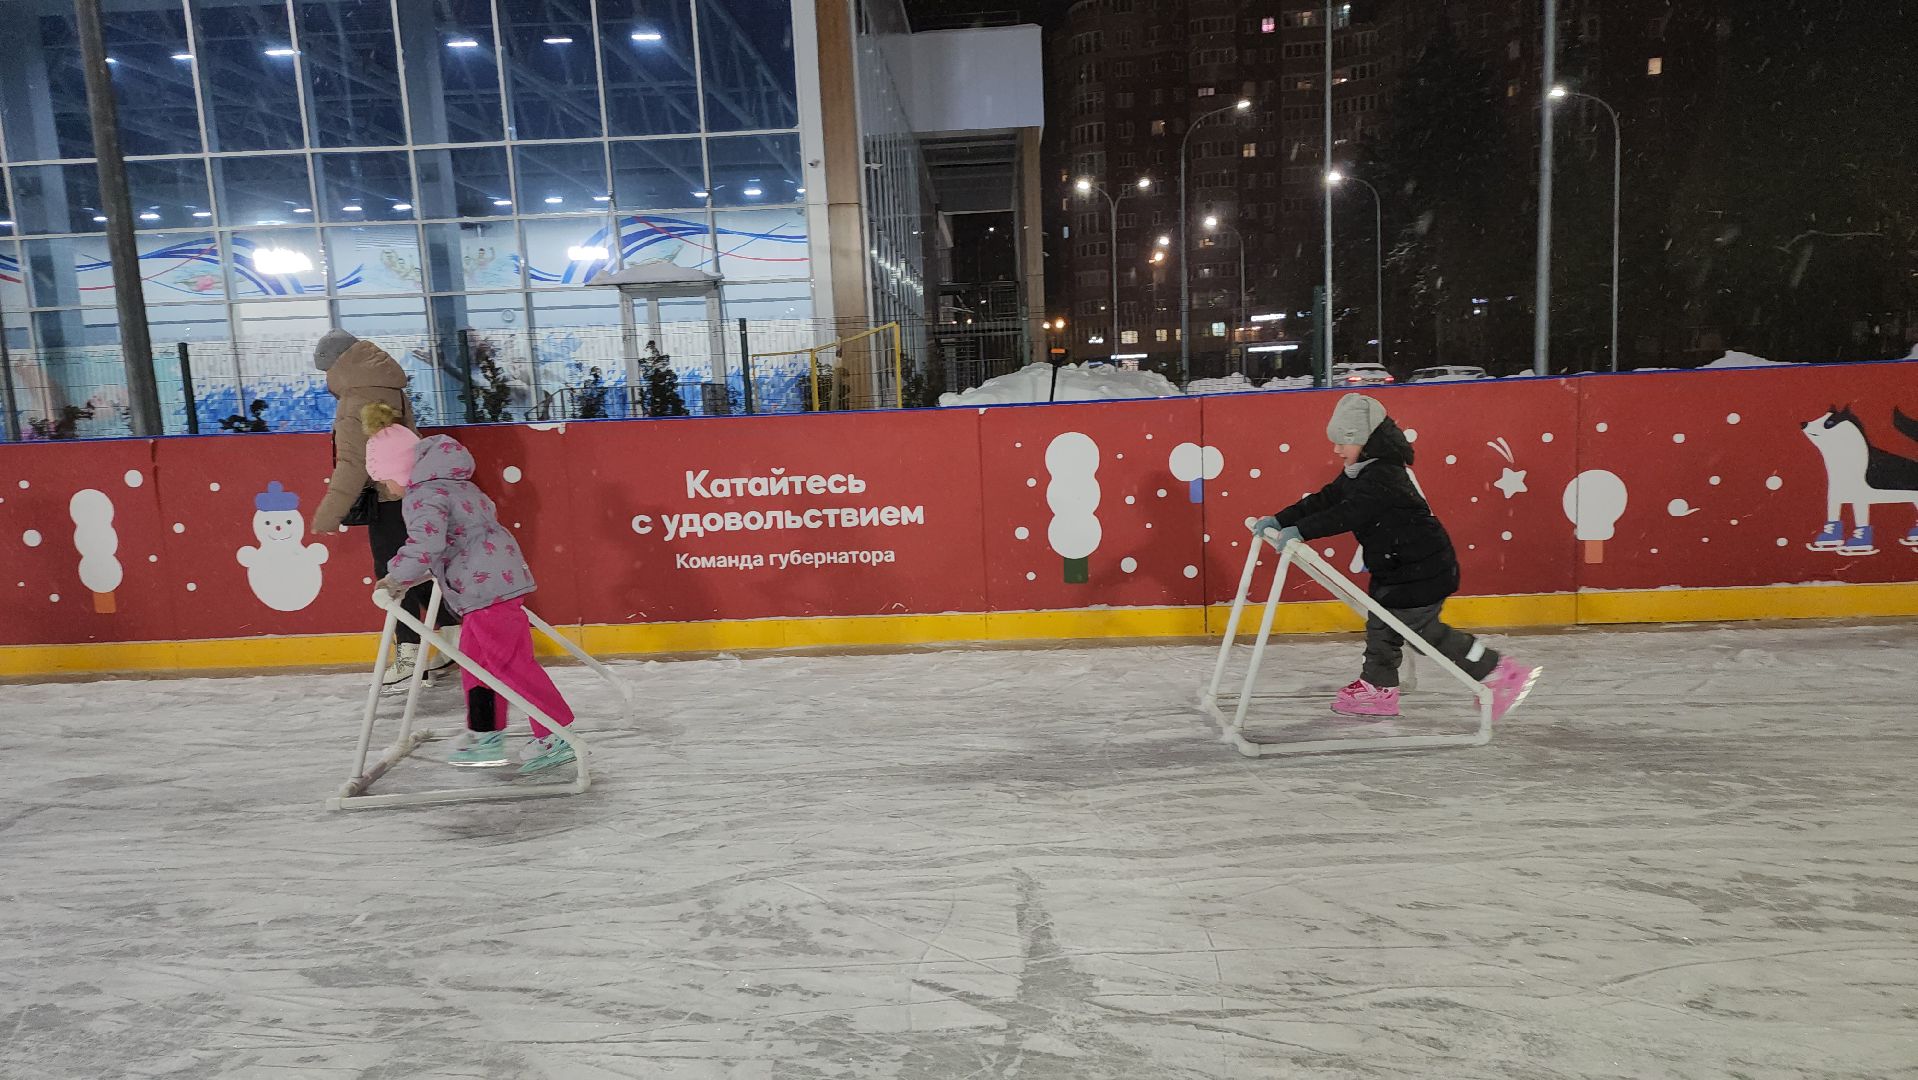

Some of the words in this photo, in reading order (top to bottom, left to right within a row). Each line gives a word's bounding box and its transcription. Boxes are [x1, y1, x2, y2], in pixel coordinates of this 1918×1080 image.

[685, 467, 867, 499] Катайтесь
[631, 514, 652, 534] с
[661, 505, 925, 542] удовольствием
[676, 552, 764, 570] Команда
[769, 549, 895, 570] губернатора
